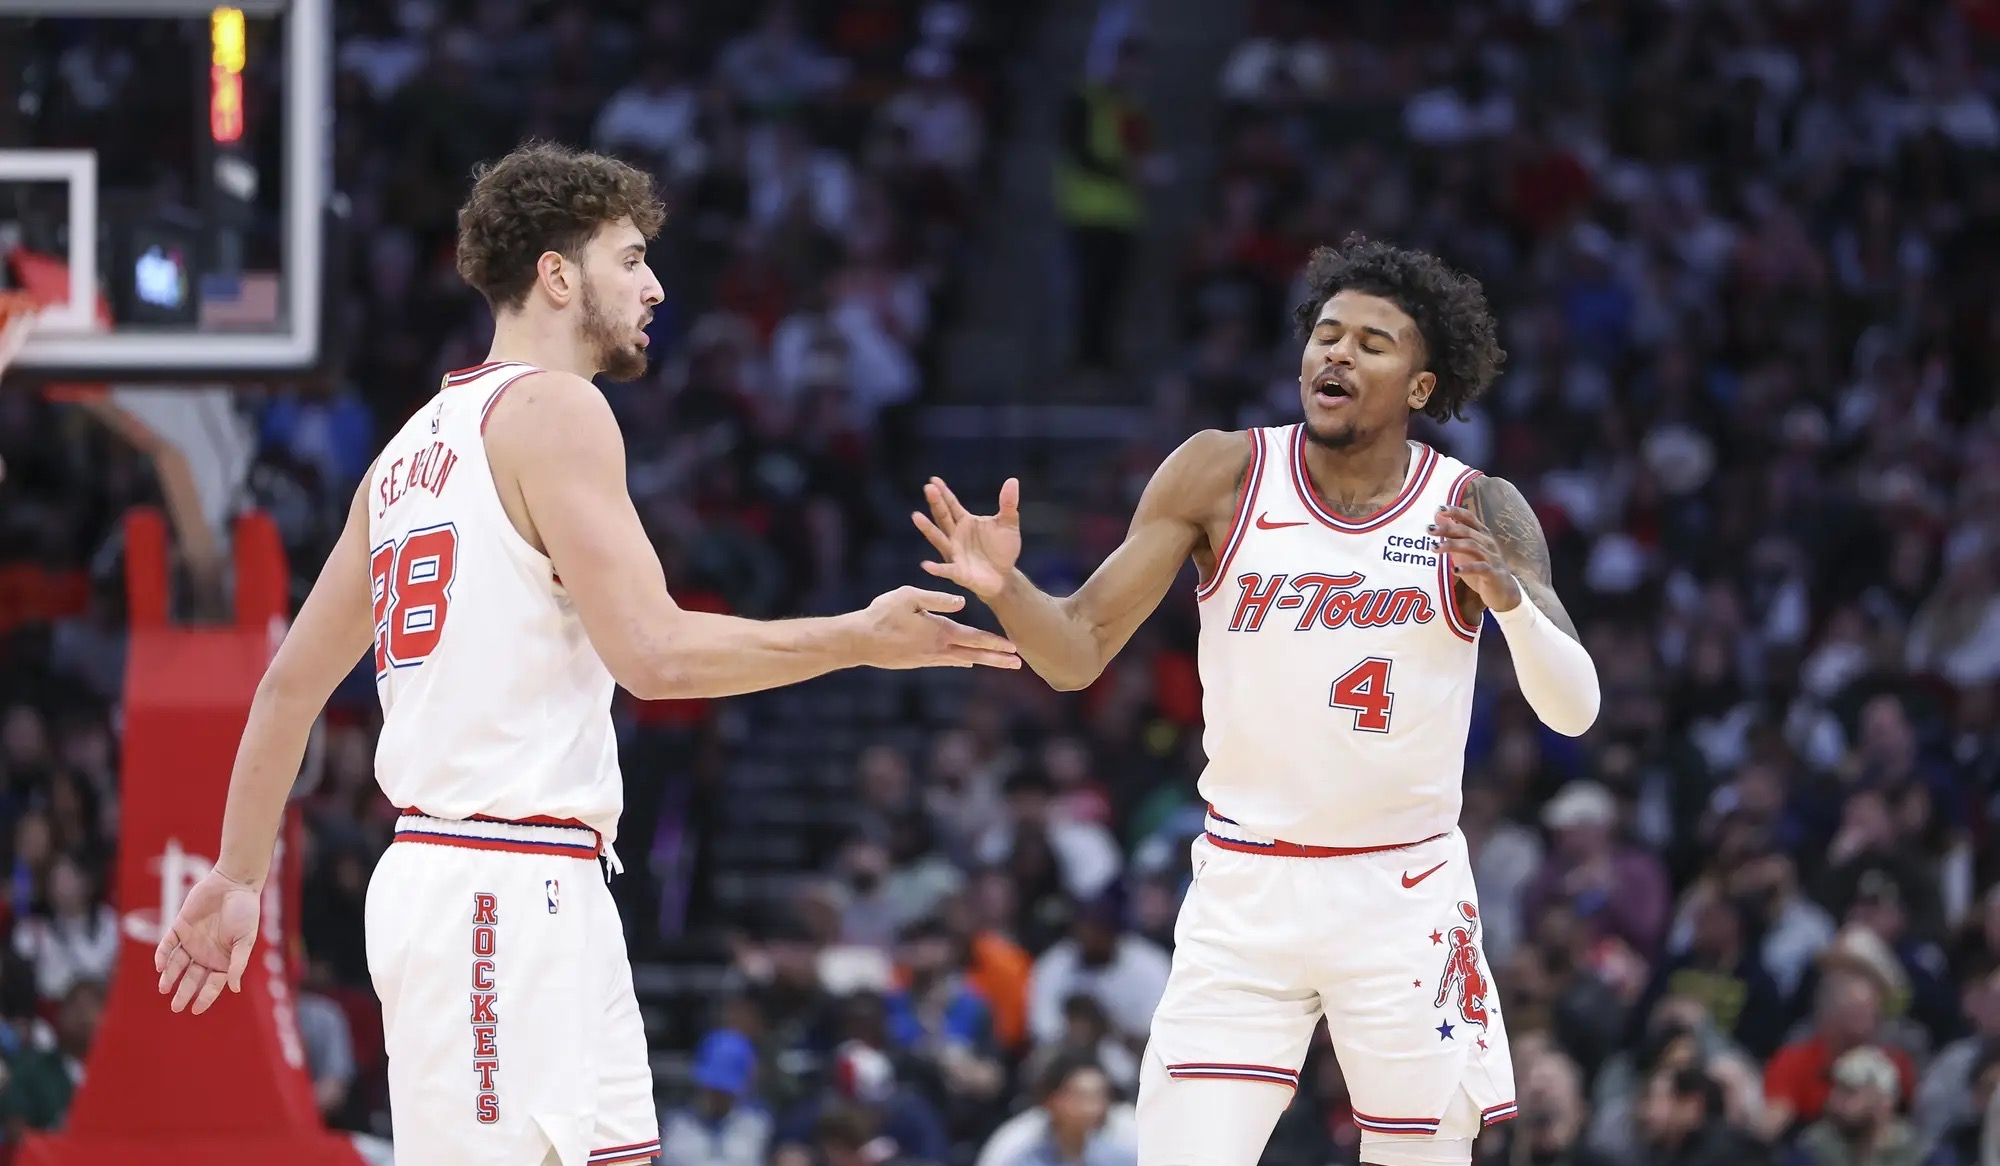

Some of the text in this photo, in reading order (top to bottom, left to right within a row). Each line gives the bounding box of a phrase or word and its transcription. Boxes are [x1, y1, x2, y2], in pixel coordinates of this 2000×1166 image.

[1383, 546, 1437, 567] karma
[1228, 571, 1436, 632] H-Town
[1329, 656, 1394, 734] 4
[472, 892, 499, 1124] ROCKETS
